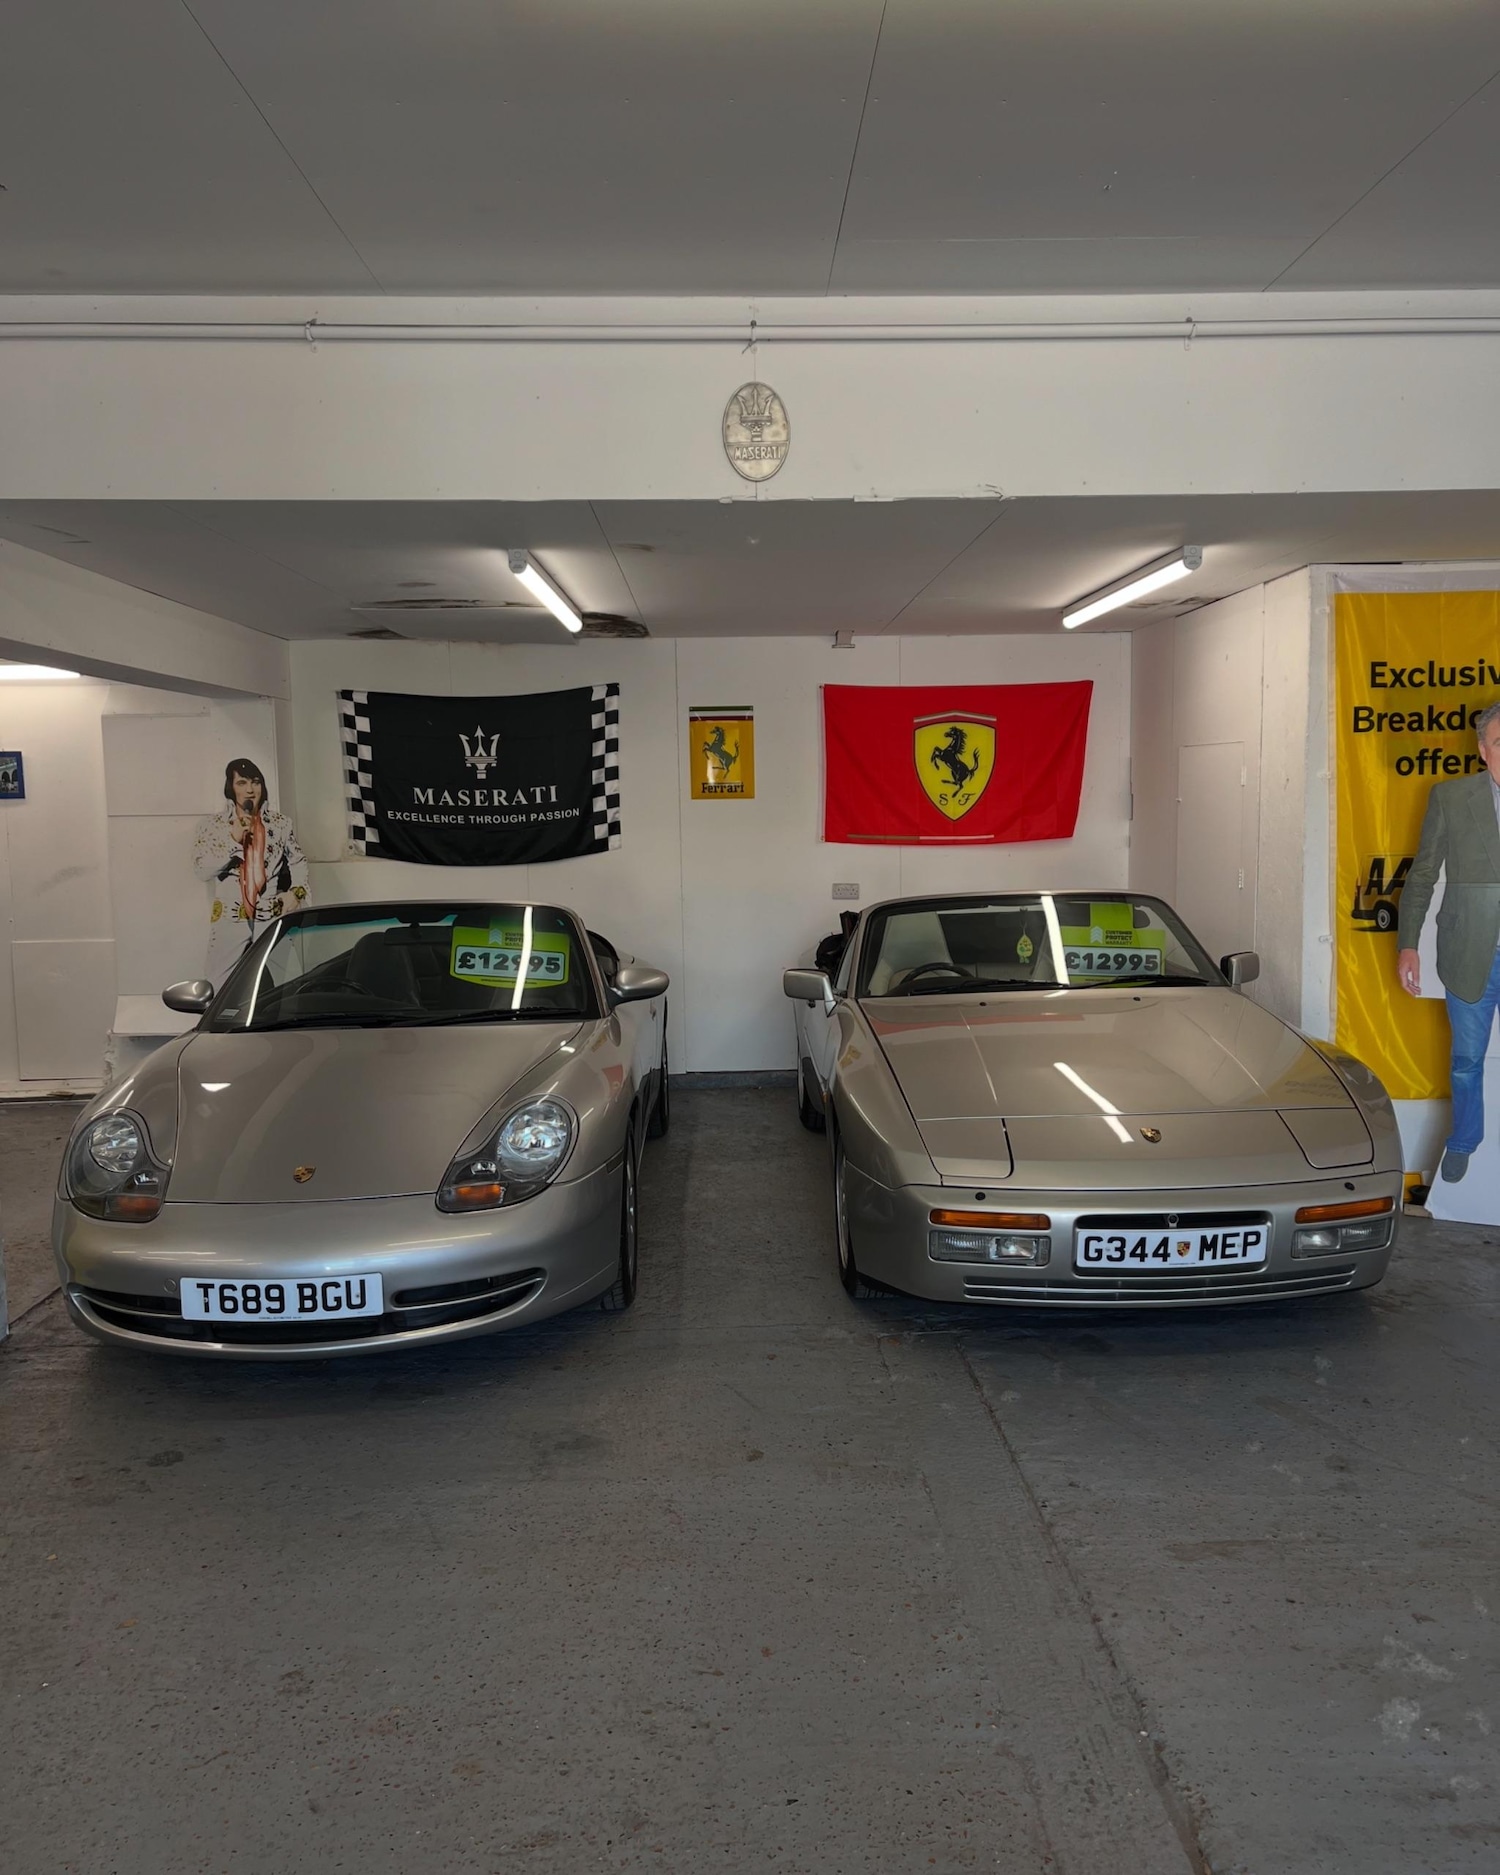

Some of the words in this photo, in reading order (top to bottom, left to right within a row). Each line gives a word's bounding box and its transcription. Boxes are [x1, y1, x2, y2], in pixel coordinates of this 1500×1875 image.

[734, 446, 781, 460] MASERATI
[1370, 658, 1500, 688] Exclusiv
[413, 785, 558, 807] MASERATI
[701, 782, 744, 793] Ferrari
[387, 810, 465, 824] EXCELLENCE
[468, 814, 527, 824] THROUGH
[531, 808, 580, 822] PASSION
[1065, 952, 1159, 971] £12995
[1083, 1236, 1171, 1262] G344
[1199, 1231, 1261, 1261] MEP
[196, 1283, 285, 1314] T689
[296, 1279, 366, 1313] BGU
